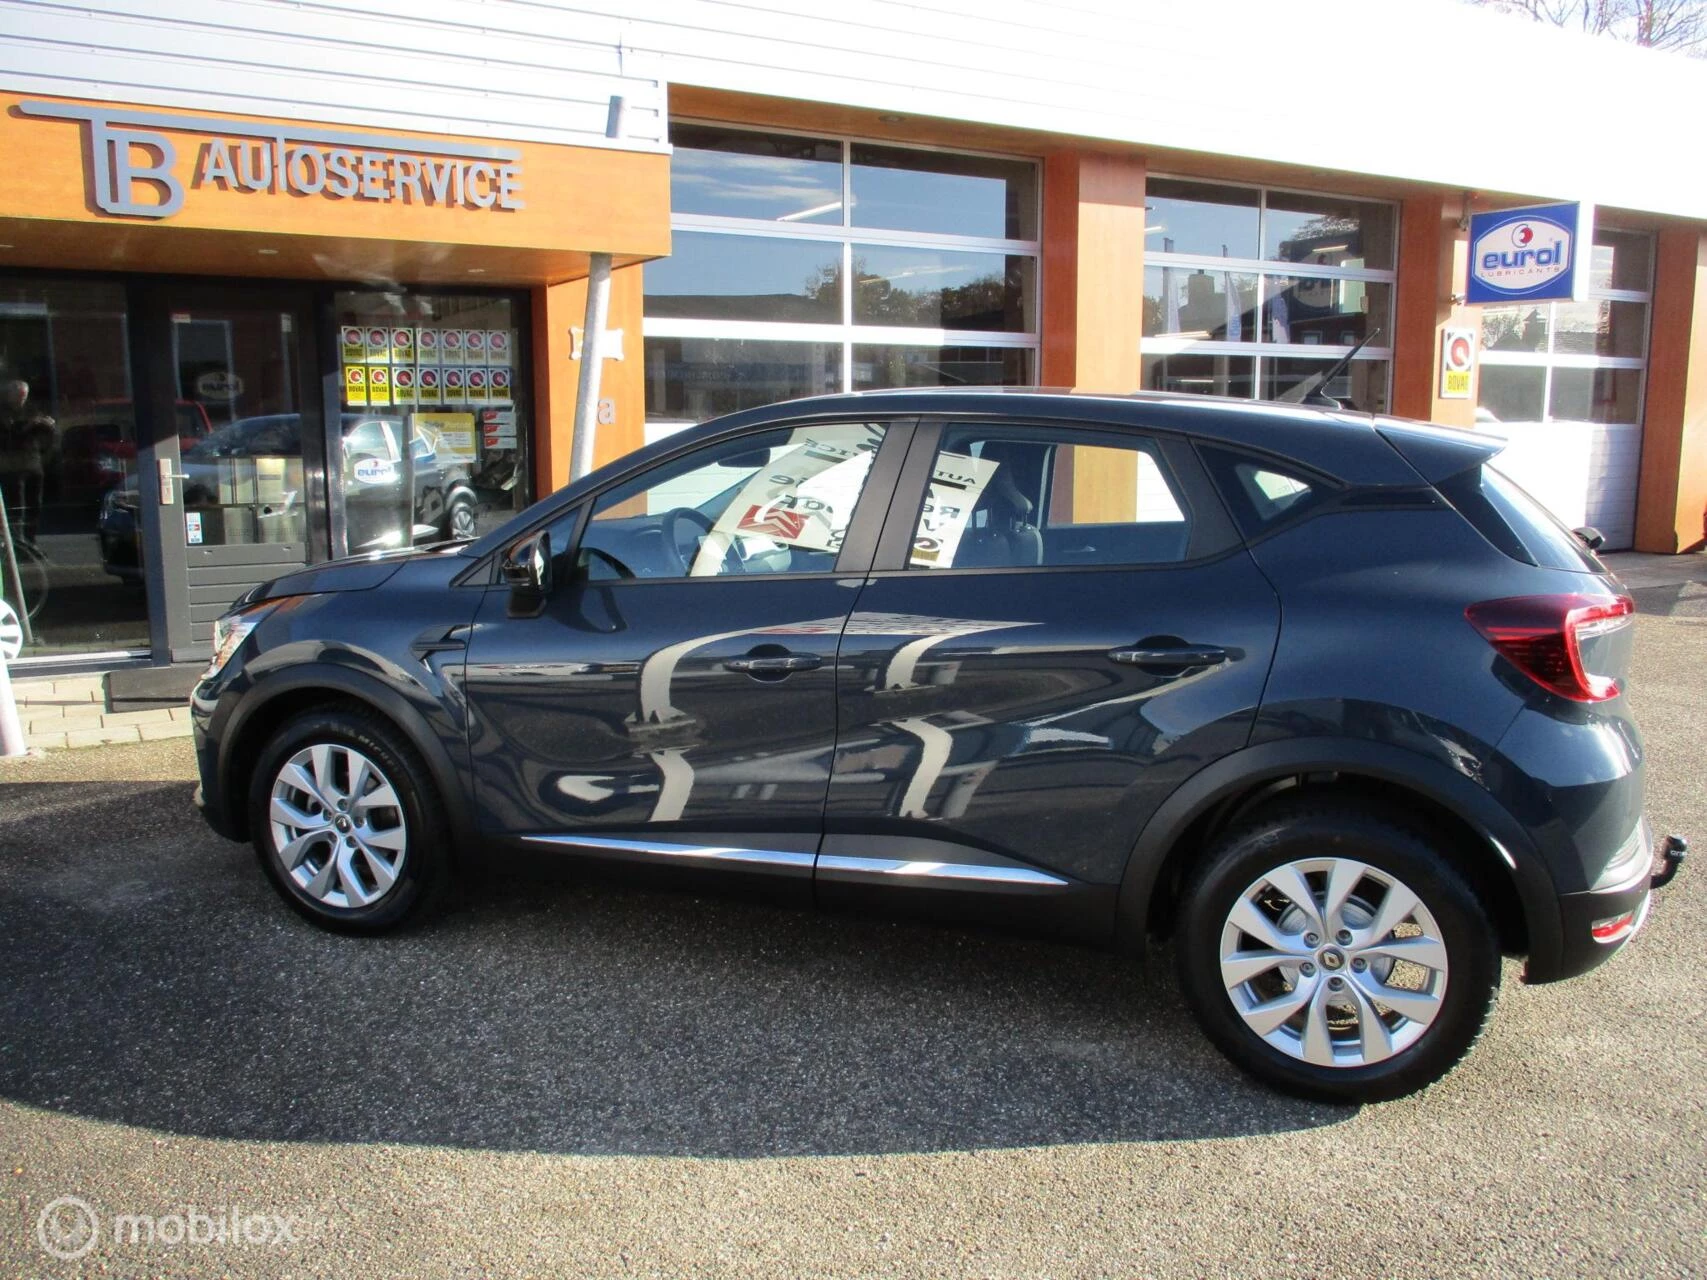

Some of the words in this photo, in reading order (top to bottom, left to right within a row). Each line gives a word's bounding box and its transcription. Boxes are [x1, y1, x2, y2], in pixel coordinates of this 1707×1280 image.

[203, 135, 525, 210] AUTOSERVICE
[1482, 240, 1562, 270] eurol
[1481, 265, 1560, 277] LUBRICANTS
